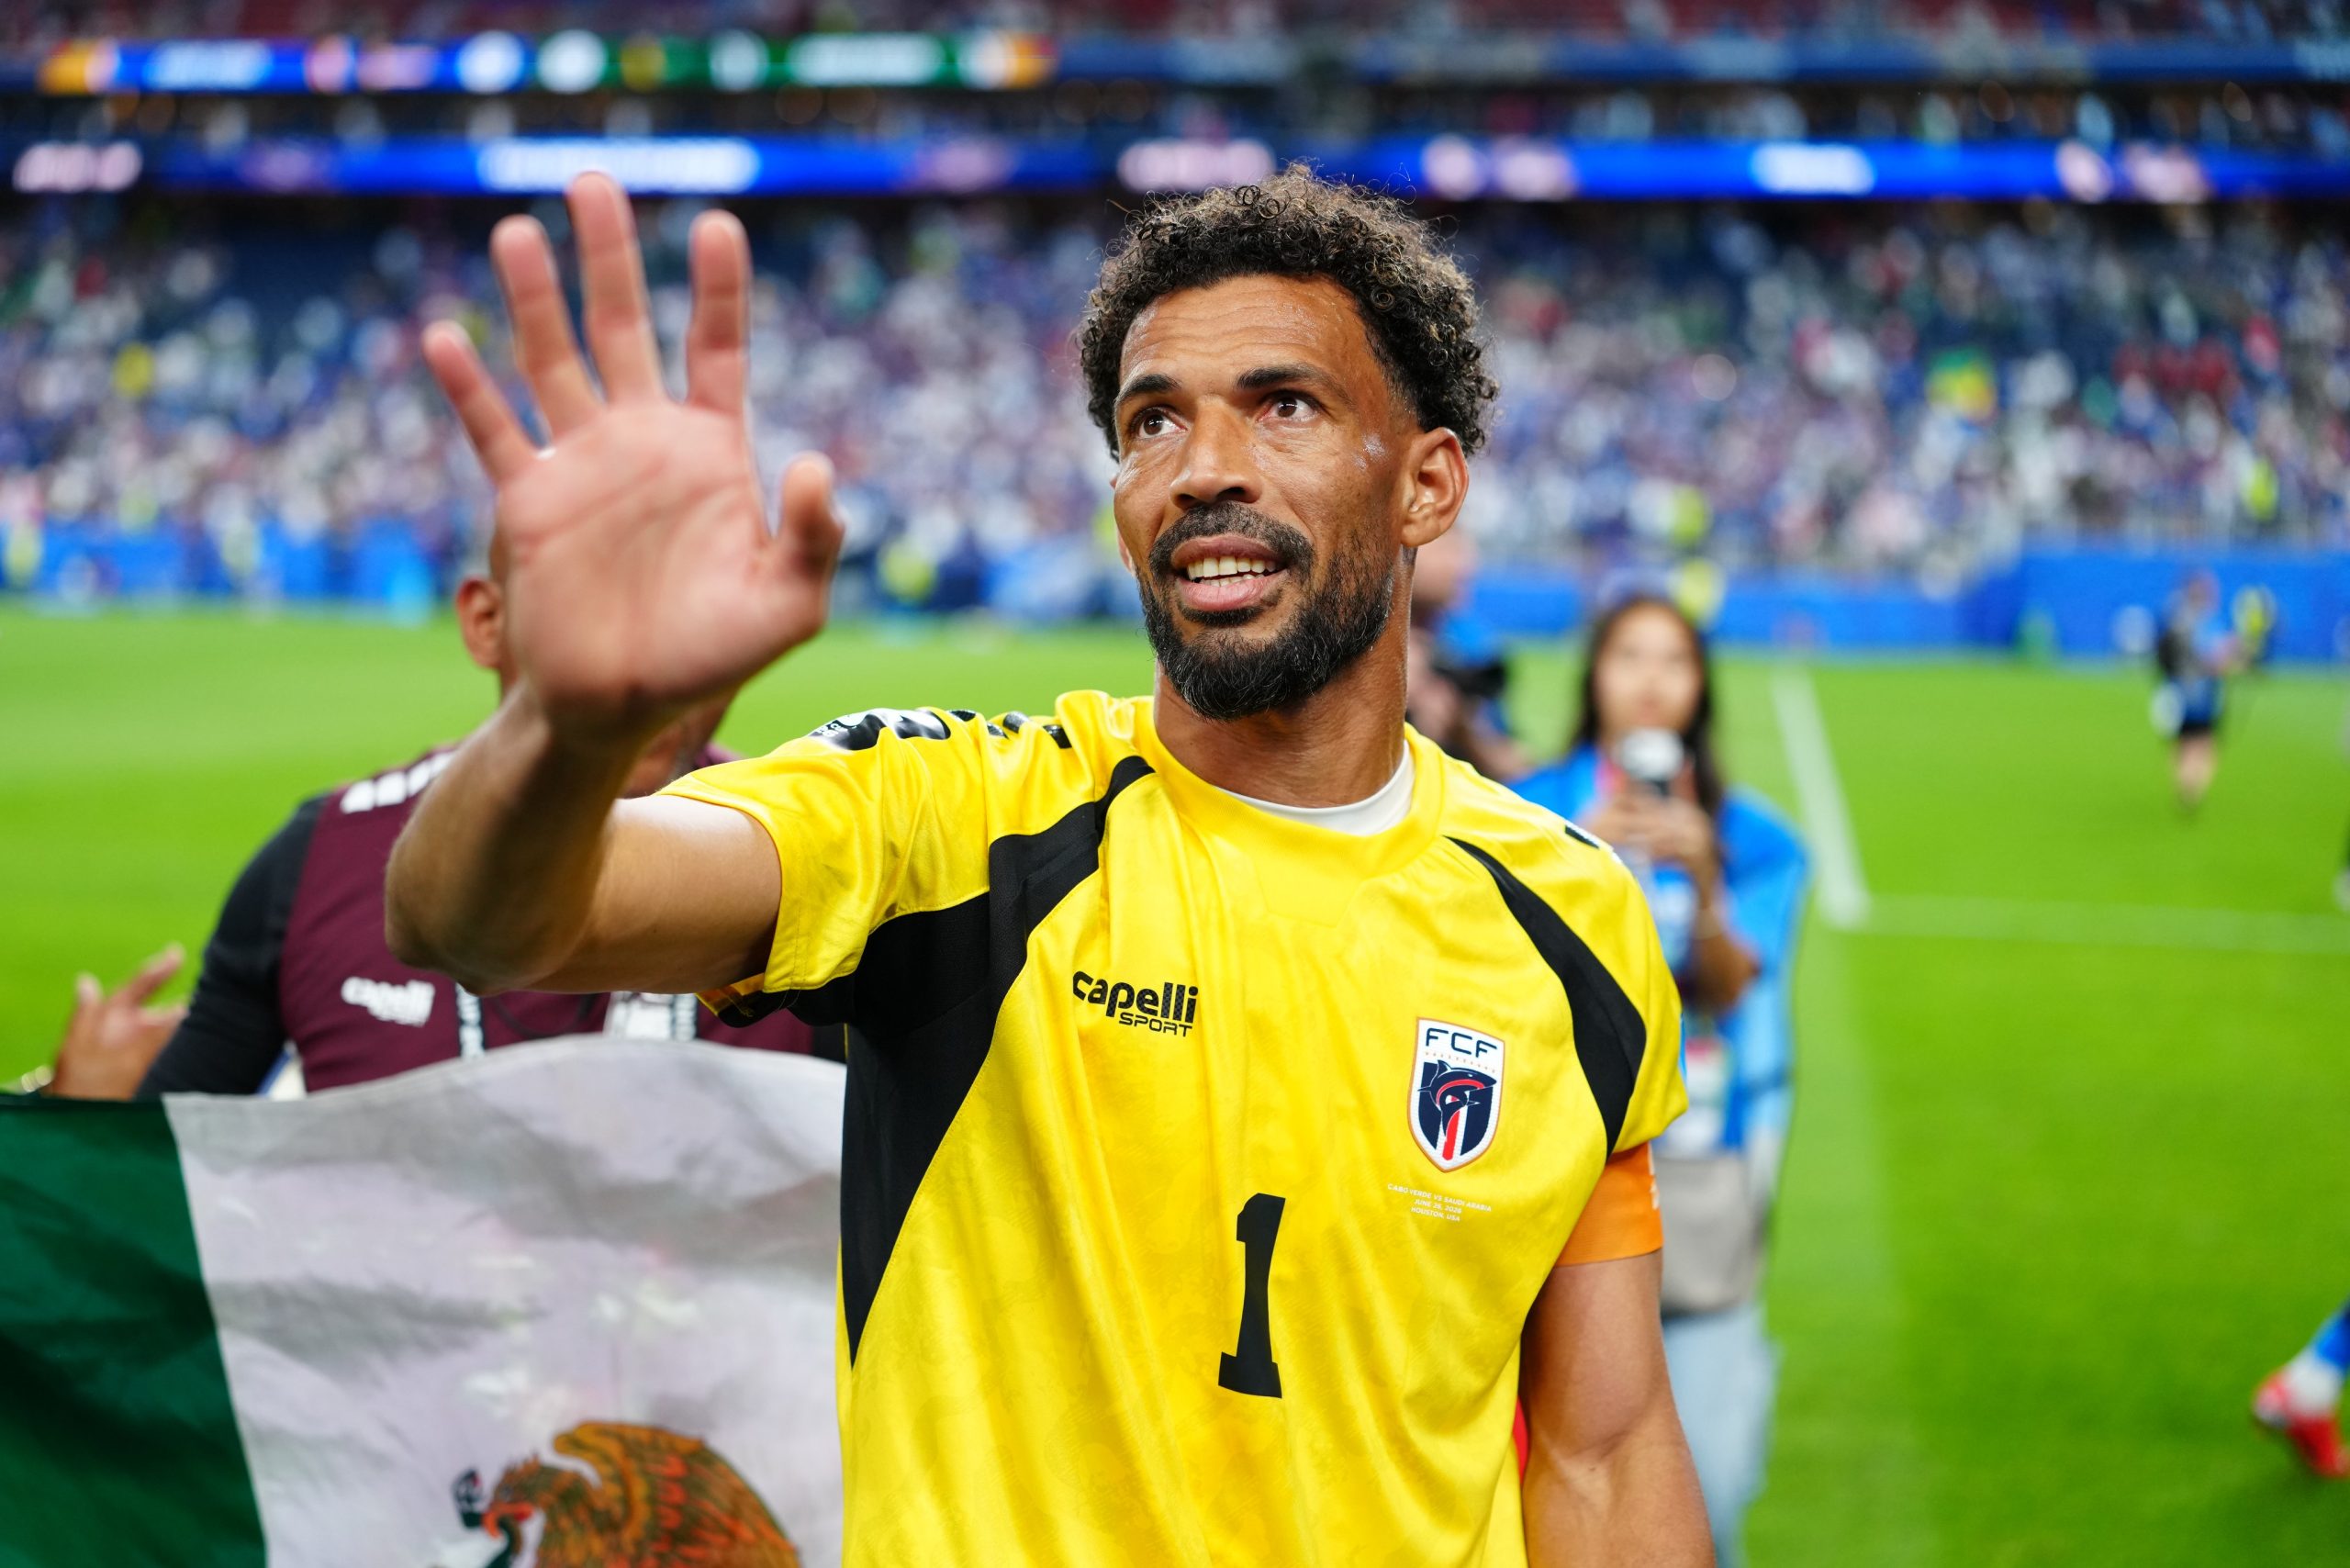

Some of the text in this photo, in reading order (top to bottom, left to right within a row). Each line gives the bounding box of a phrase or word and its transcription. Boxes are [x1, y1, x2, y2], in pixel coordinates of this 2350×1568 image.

[1072, 970, 1199, 1024] capelli
[1118, 1012, 1193, 1037] SPORT
[1425, 1027, 1498, 1058] FCF
[1387, 1183, 1492, 1212] CABO VERDE VS SAUDI ARABIA
[1414, 1199, 1432, 1207] JUNE
[1446, 1214, 1460, 1222] USA
[1217, 1193, 1286, 1399] 1
